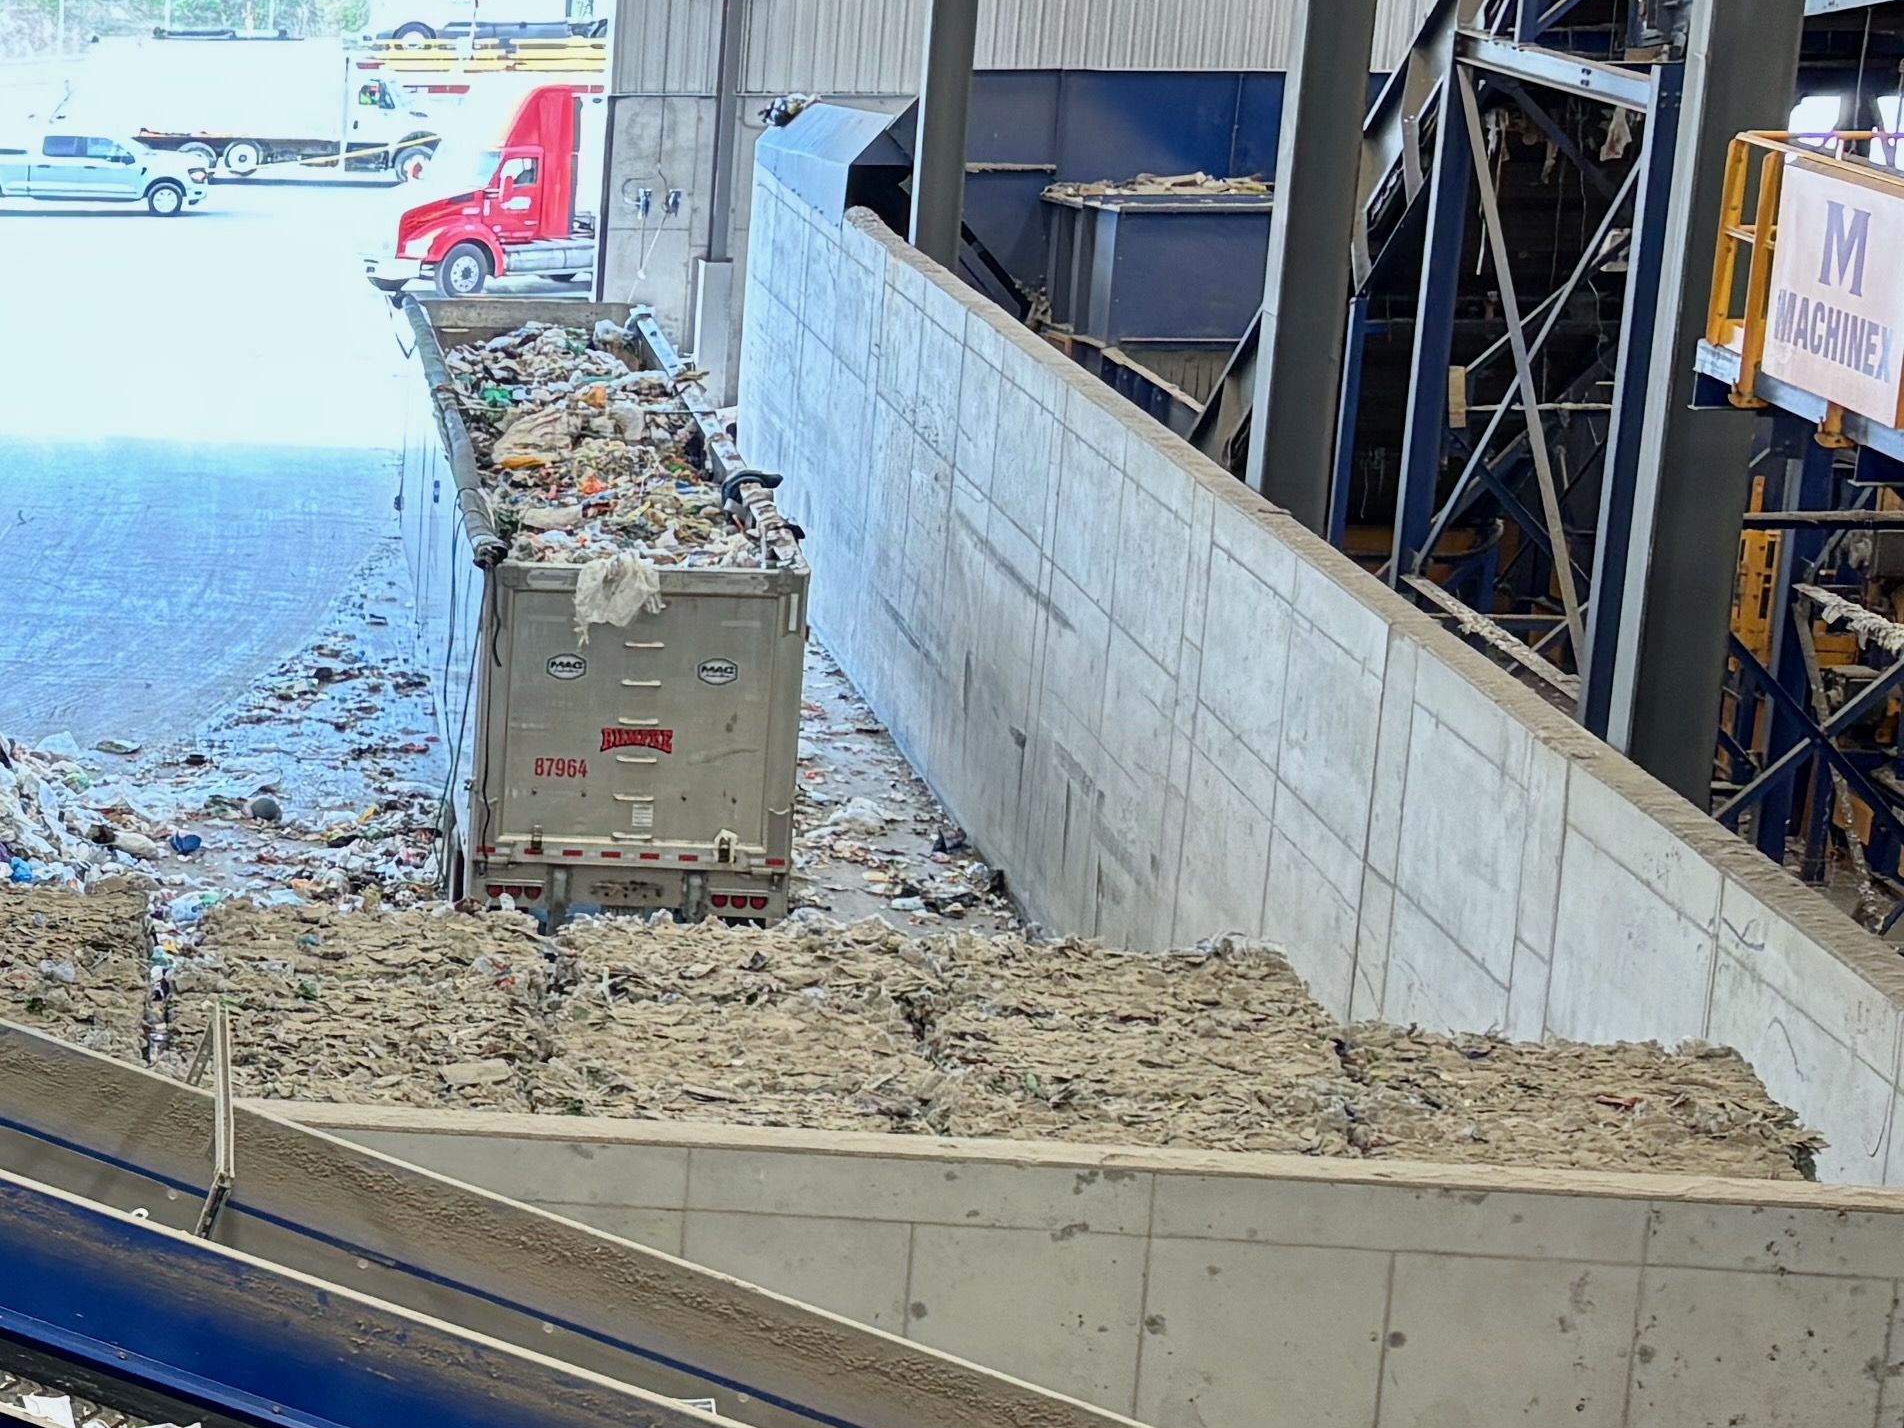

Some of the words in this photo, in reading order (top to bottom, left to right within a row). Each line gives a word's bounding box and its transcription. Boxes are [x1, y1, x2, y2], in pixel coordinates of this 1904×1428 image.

[1818, 199, 1872, 297] M
[1775, 289, 1894, 383] MACHINEX
[550, 661, 584, 670] MAC
[701, 666, 734, 675] MAC
[534, 758, 588, 778] 87964
